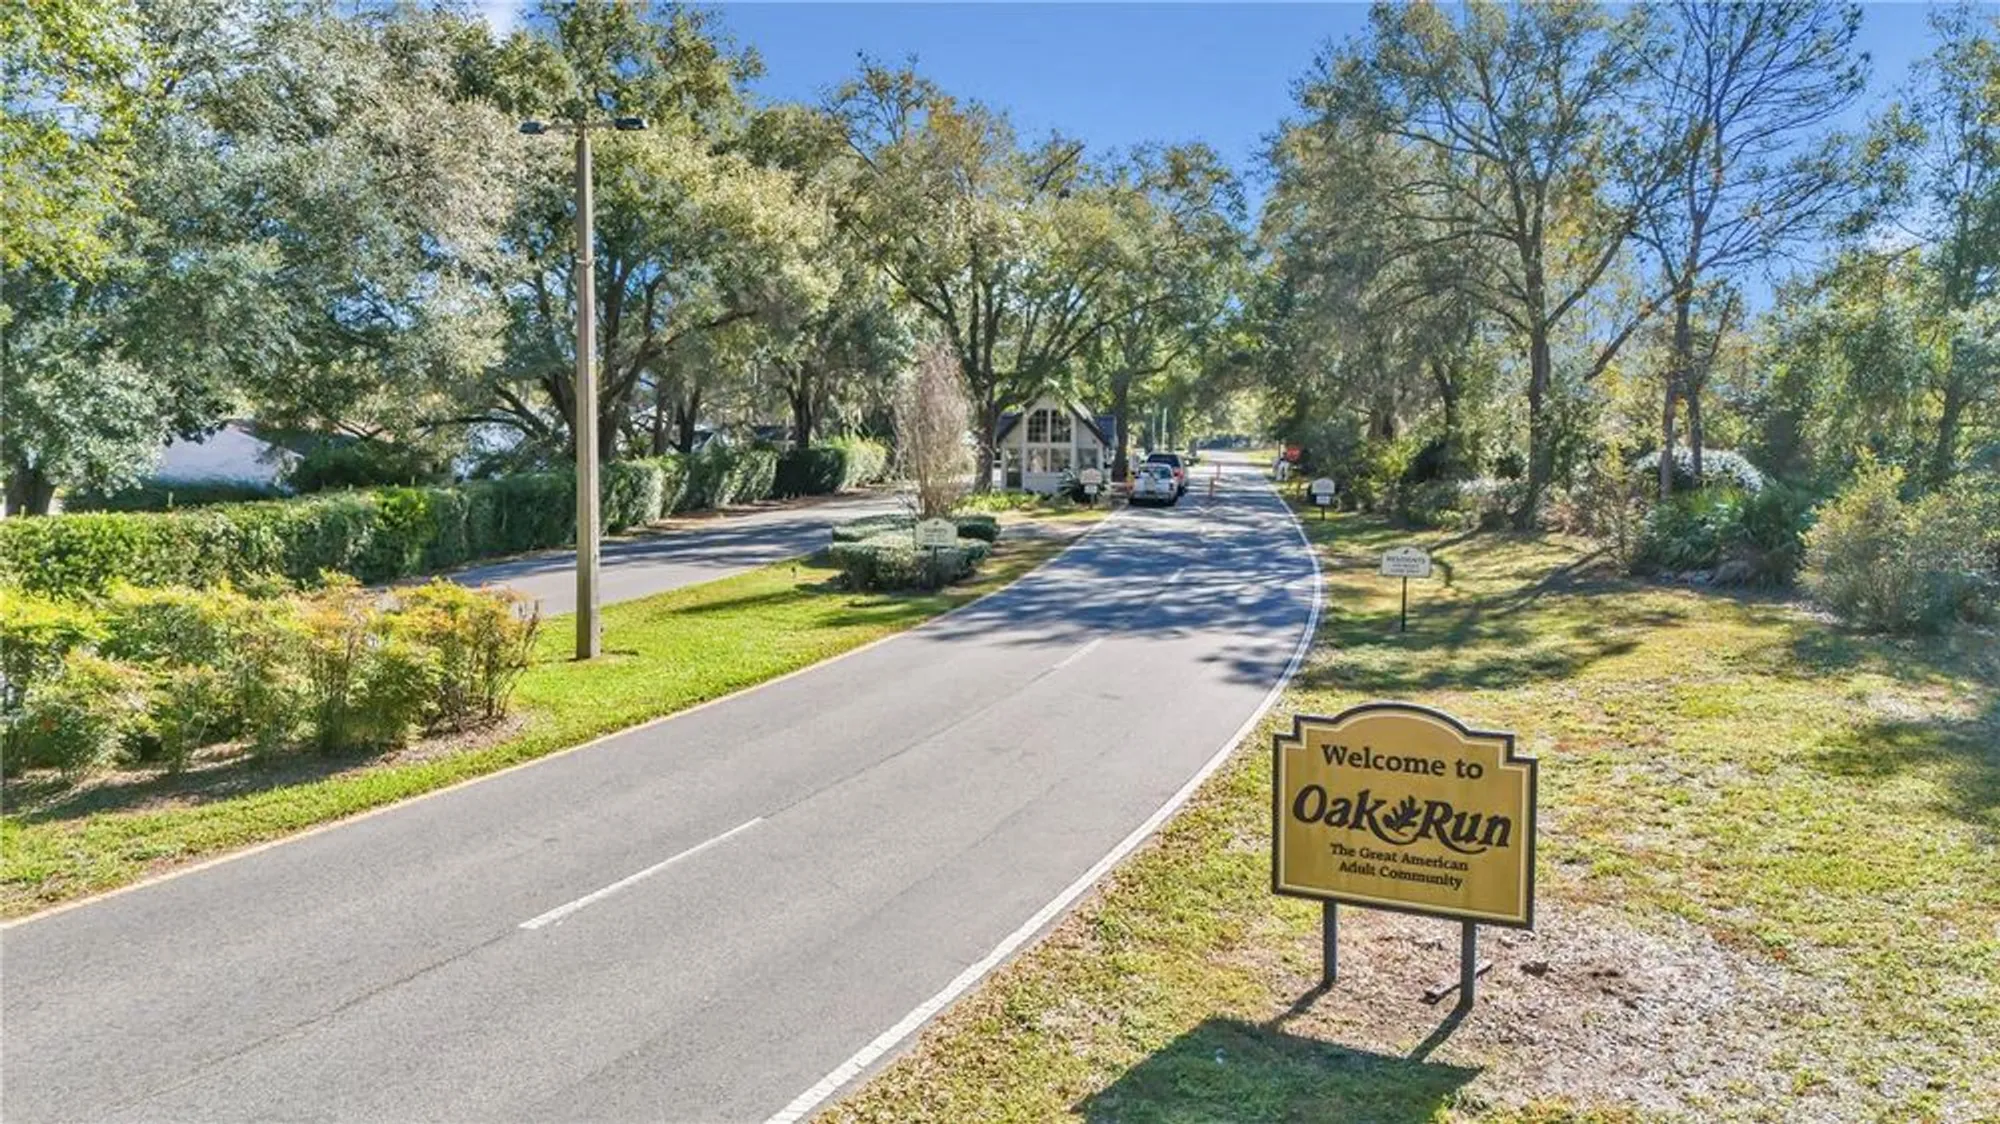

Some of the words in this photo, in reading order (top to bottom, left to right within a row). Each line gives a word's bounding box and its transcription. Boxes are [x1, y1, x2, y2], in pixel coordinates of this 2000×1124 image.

[1321, 744, 1446, 777] Welcome
[1455, 758, 1483, 780] to
[1293, 784, 1400, 845] Oak
[1418, 800, 1512, 855] Run
[1330, 842, 1356, 857] The
[1360, 847, 1397, 862] Great
[1401, 852, 1469, 871] American
[1339, 861, 1376, 876] Adult
[1379, 865, 1463, 890] Community
